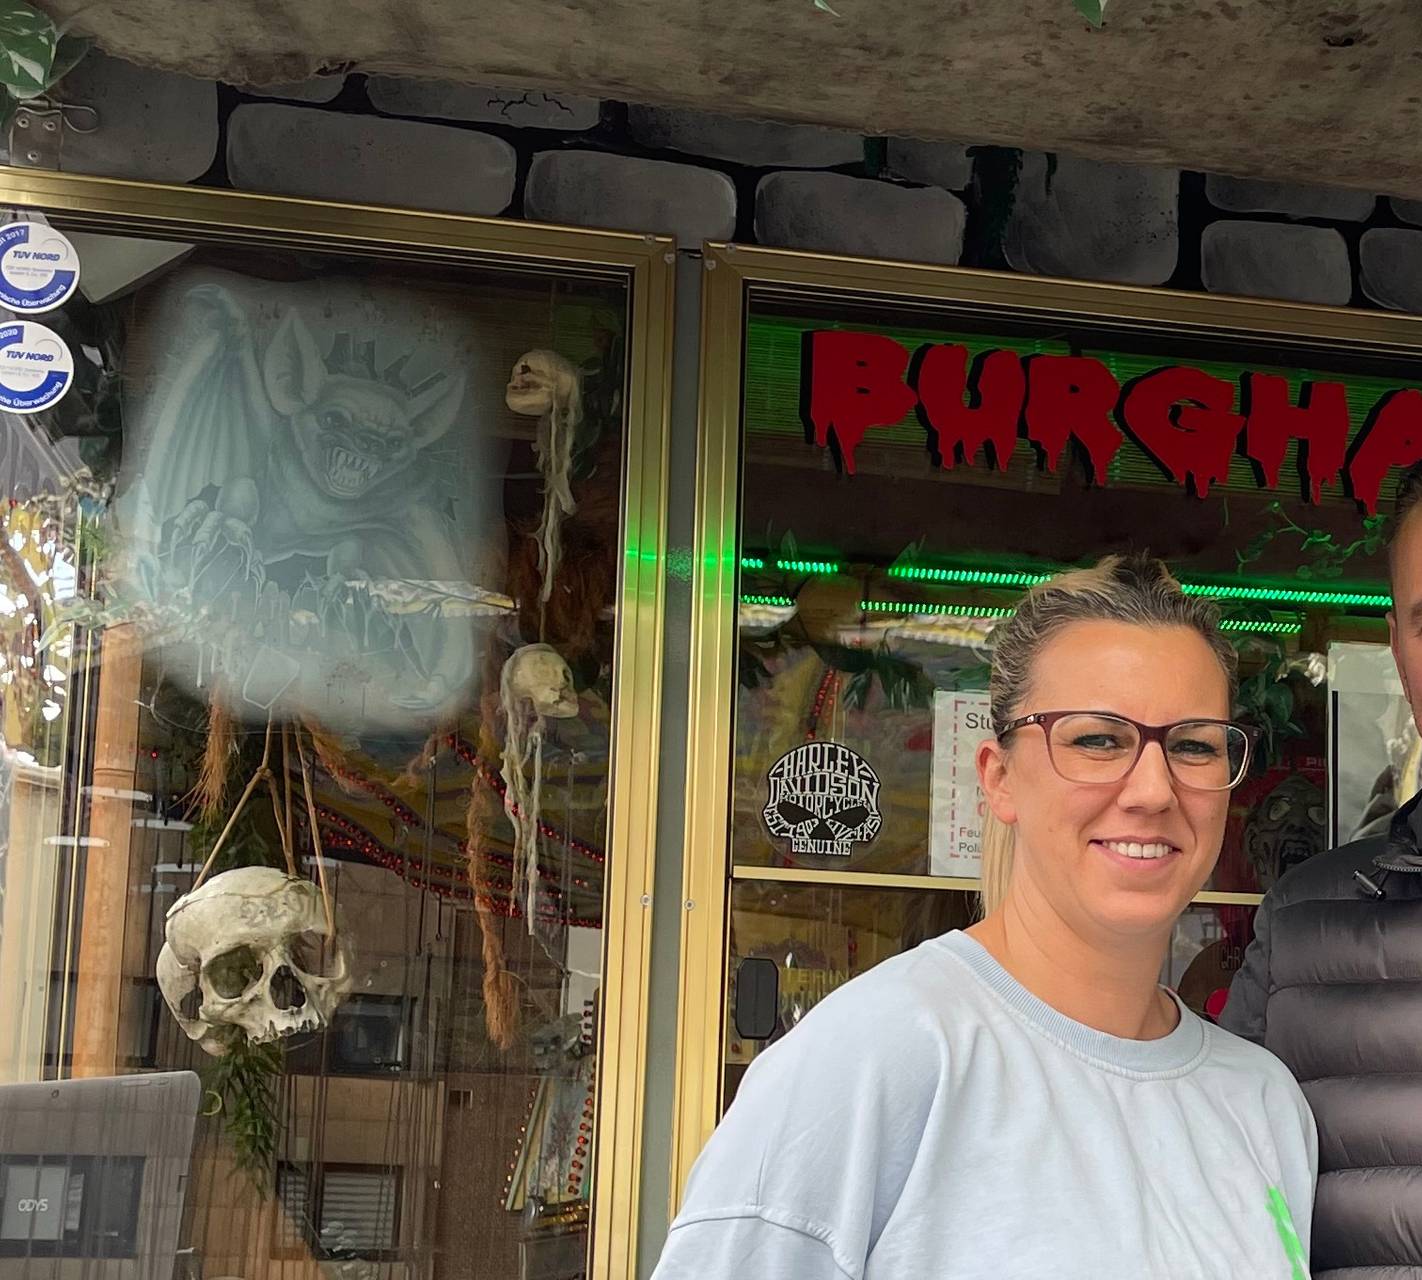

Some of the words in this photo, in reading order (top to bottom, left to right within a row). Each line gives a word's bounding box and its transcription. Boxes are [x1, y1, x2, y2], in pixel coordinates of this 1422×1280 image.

[32, 252, 61, 262] NORD
[22, 284, 67, 307] Überwachung
[26, 352, 54, 362] NORD
[13, 381, 63, 407] Überwachung
[769, 743, 880, 781] HARLEY
[768, 772, 880, 816] DAVIDSON
[791, 838, 852, 856] GENUINE
[18, 1199, 49, 1212] ODYS
